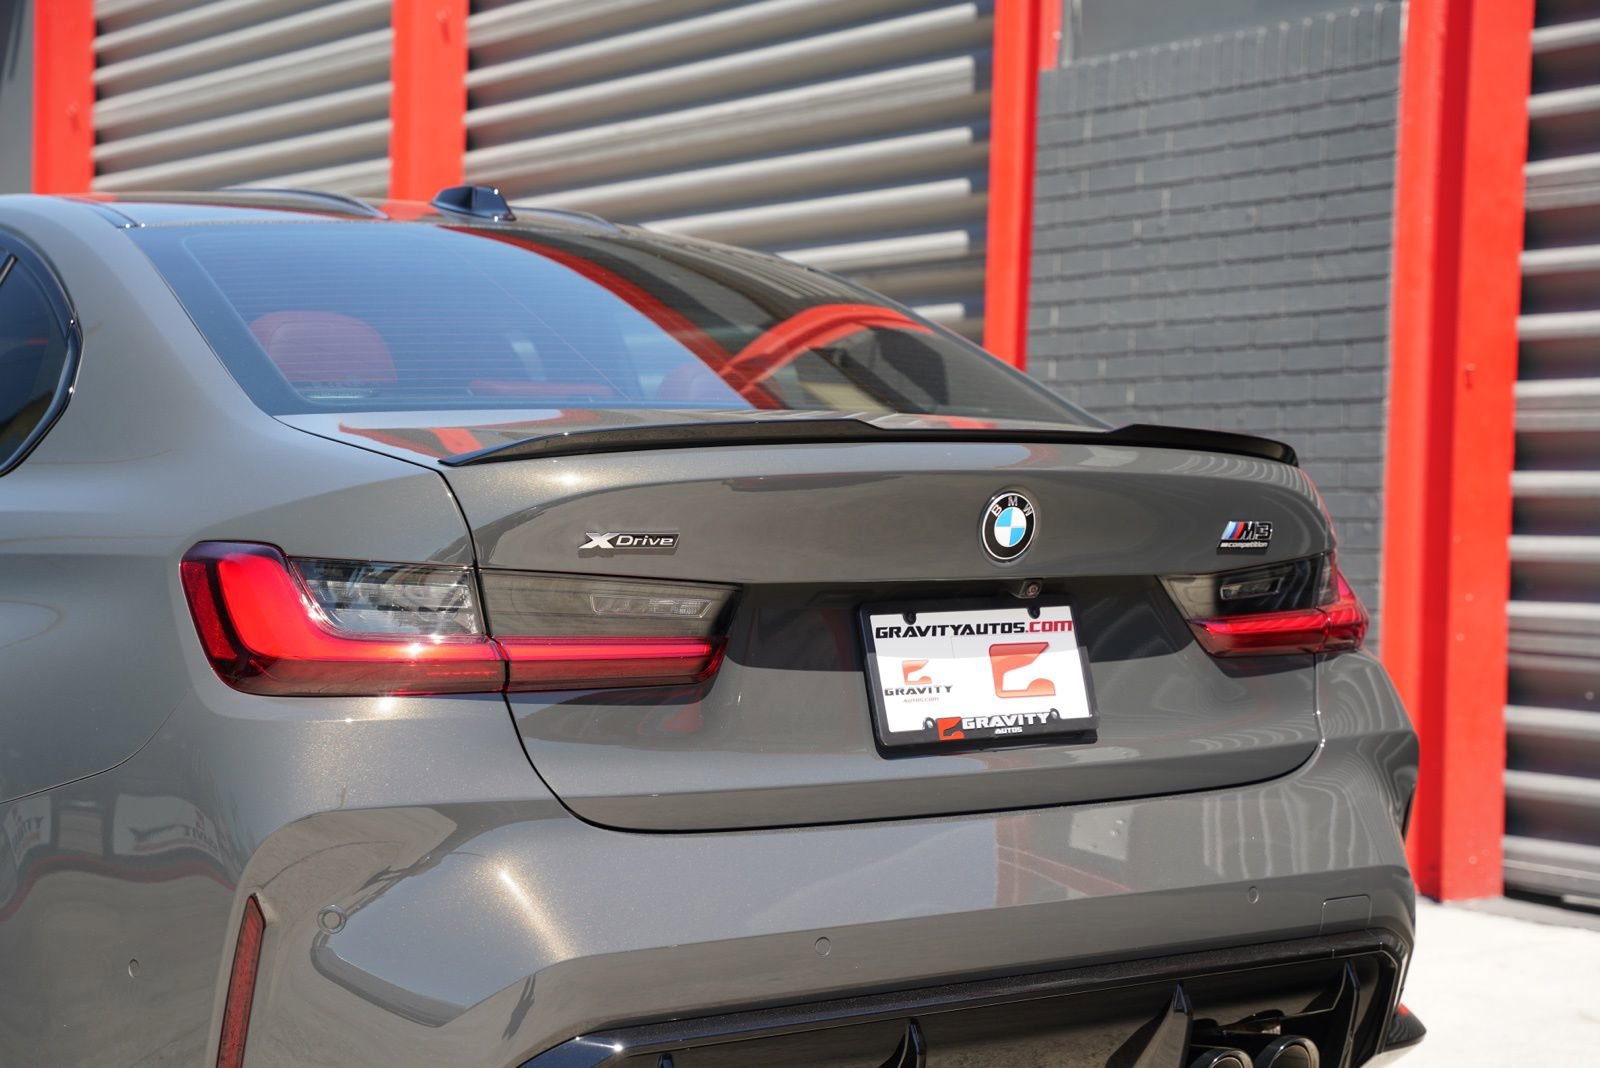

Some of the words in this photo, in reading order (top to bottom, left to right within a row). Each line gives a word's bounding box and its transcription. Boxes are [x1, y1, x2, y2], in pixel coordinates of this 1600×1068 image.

[990, 495, 1034, 518] BMW
[875, 620, 1072, 638] GRAVITYAUTOS.COM
[884, 685, 953, 696] GRAVITY
[962, 712, 1050, 729] GRAVITY
